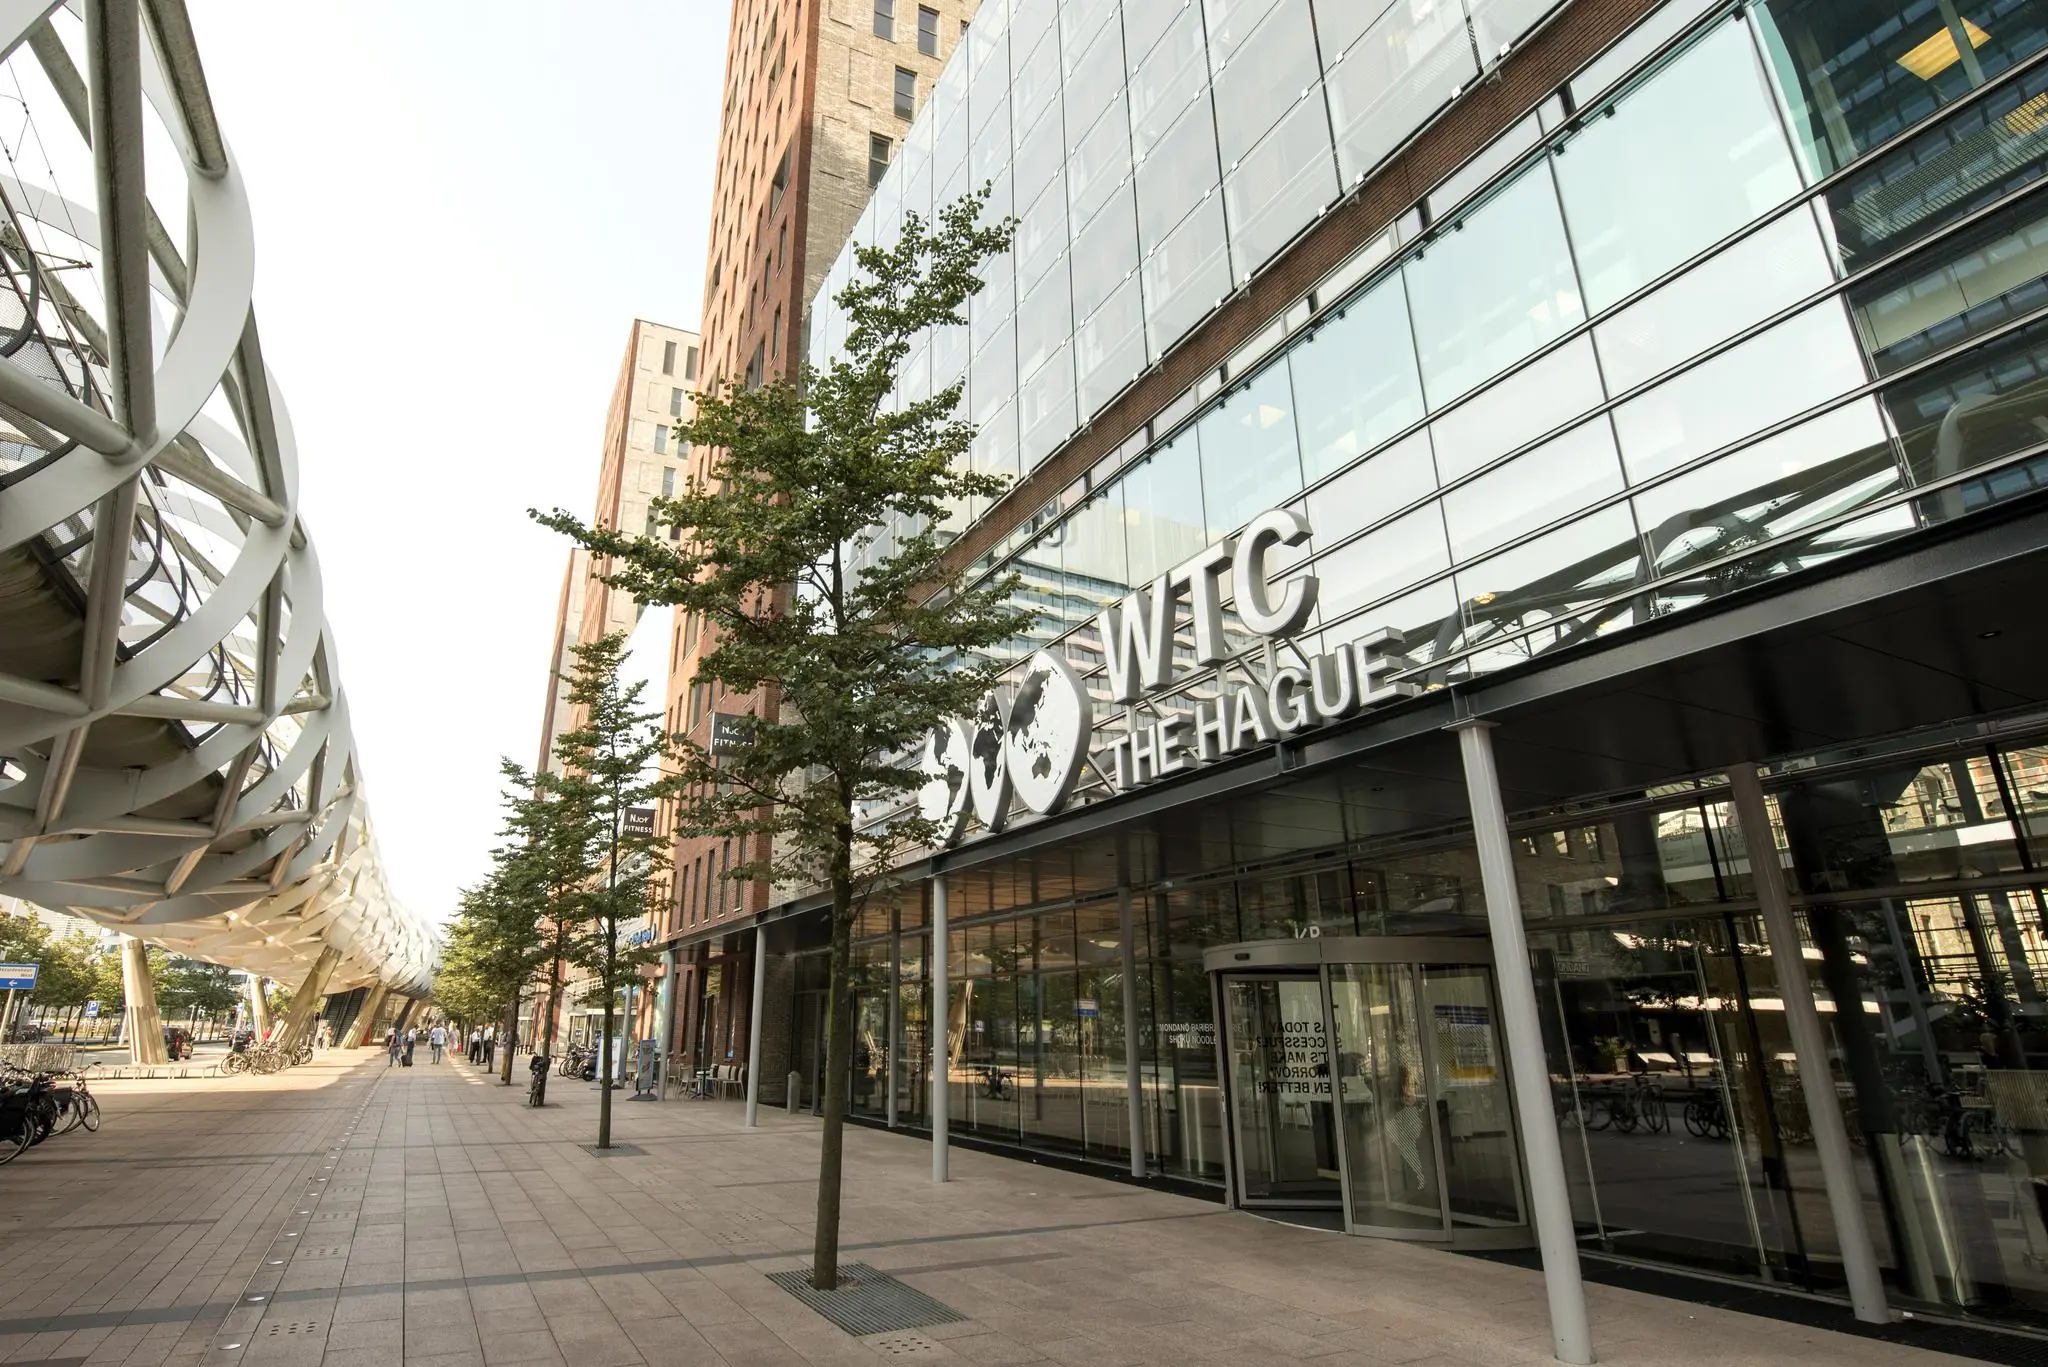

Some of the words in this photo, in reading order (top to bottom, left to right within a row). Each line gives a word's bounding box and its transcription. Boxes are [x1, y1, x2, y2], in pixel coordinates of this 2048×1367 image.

[1098, 508, 1319, 704] WTC
[1106, 711, 1197, 790] THE
[1197, 626, 1416, 762] HAGUE
[624, 825, 653, 834] FITNESS
[1159, 1023, 1190, 1032] MONDANO
